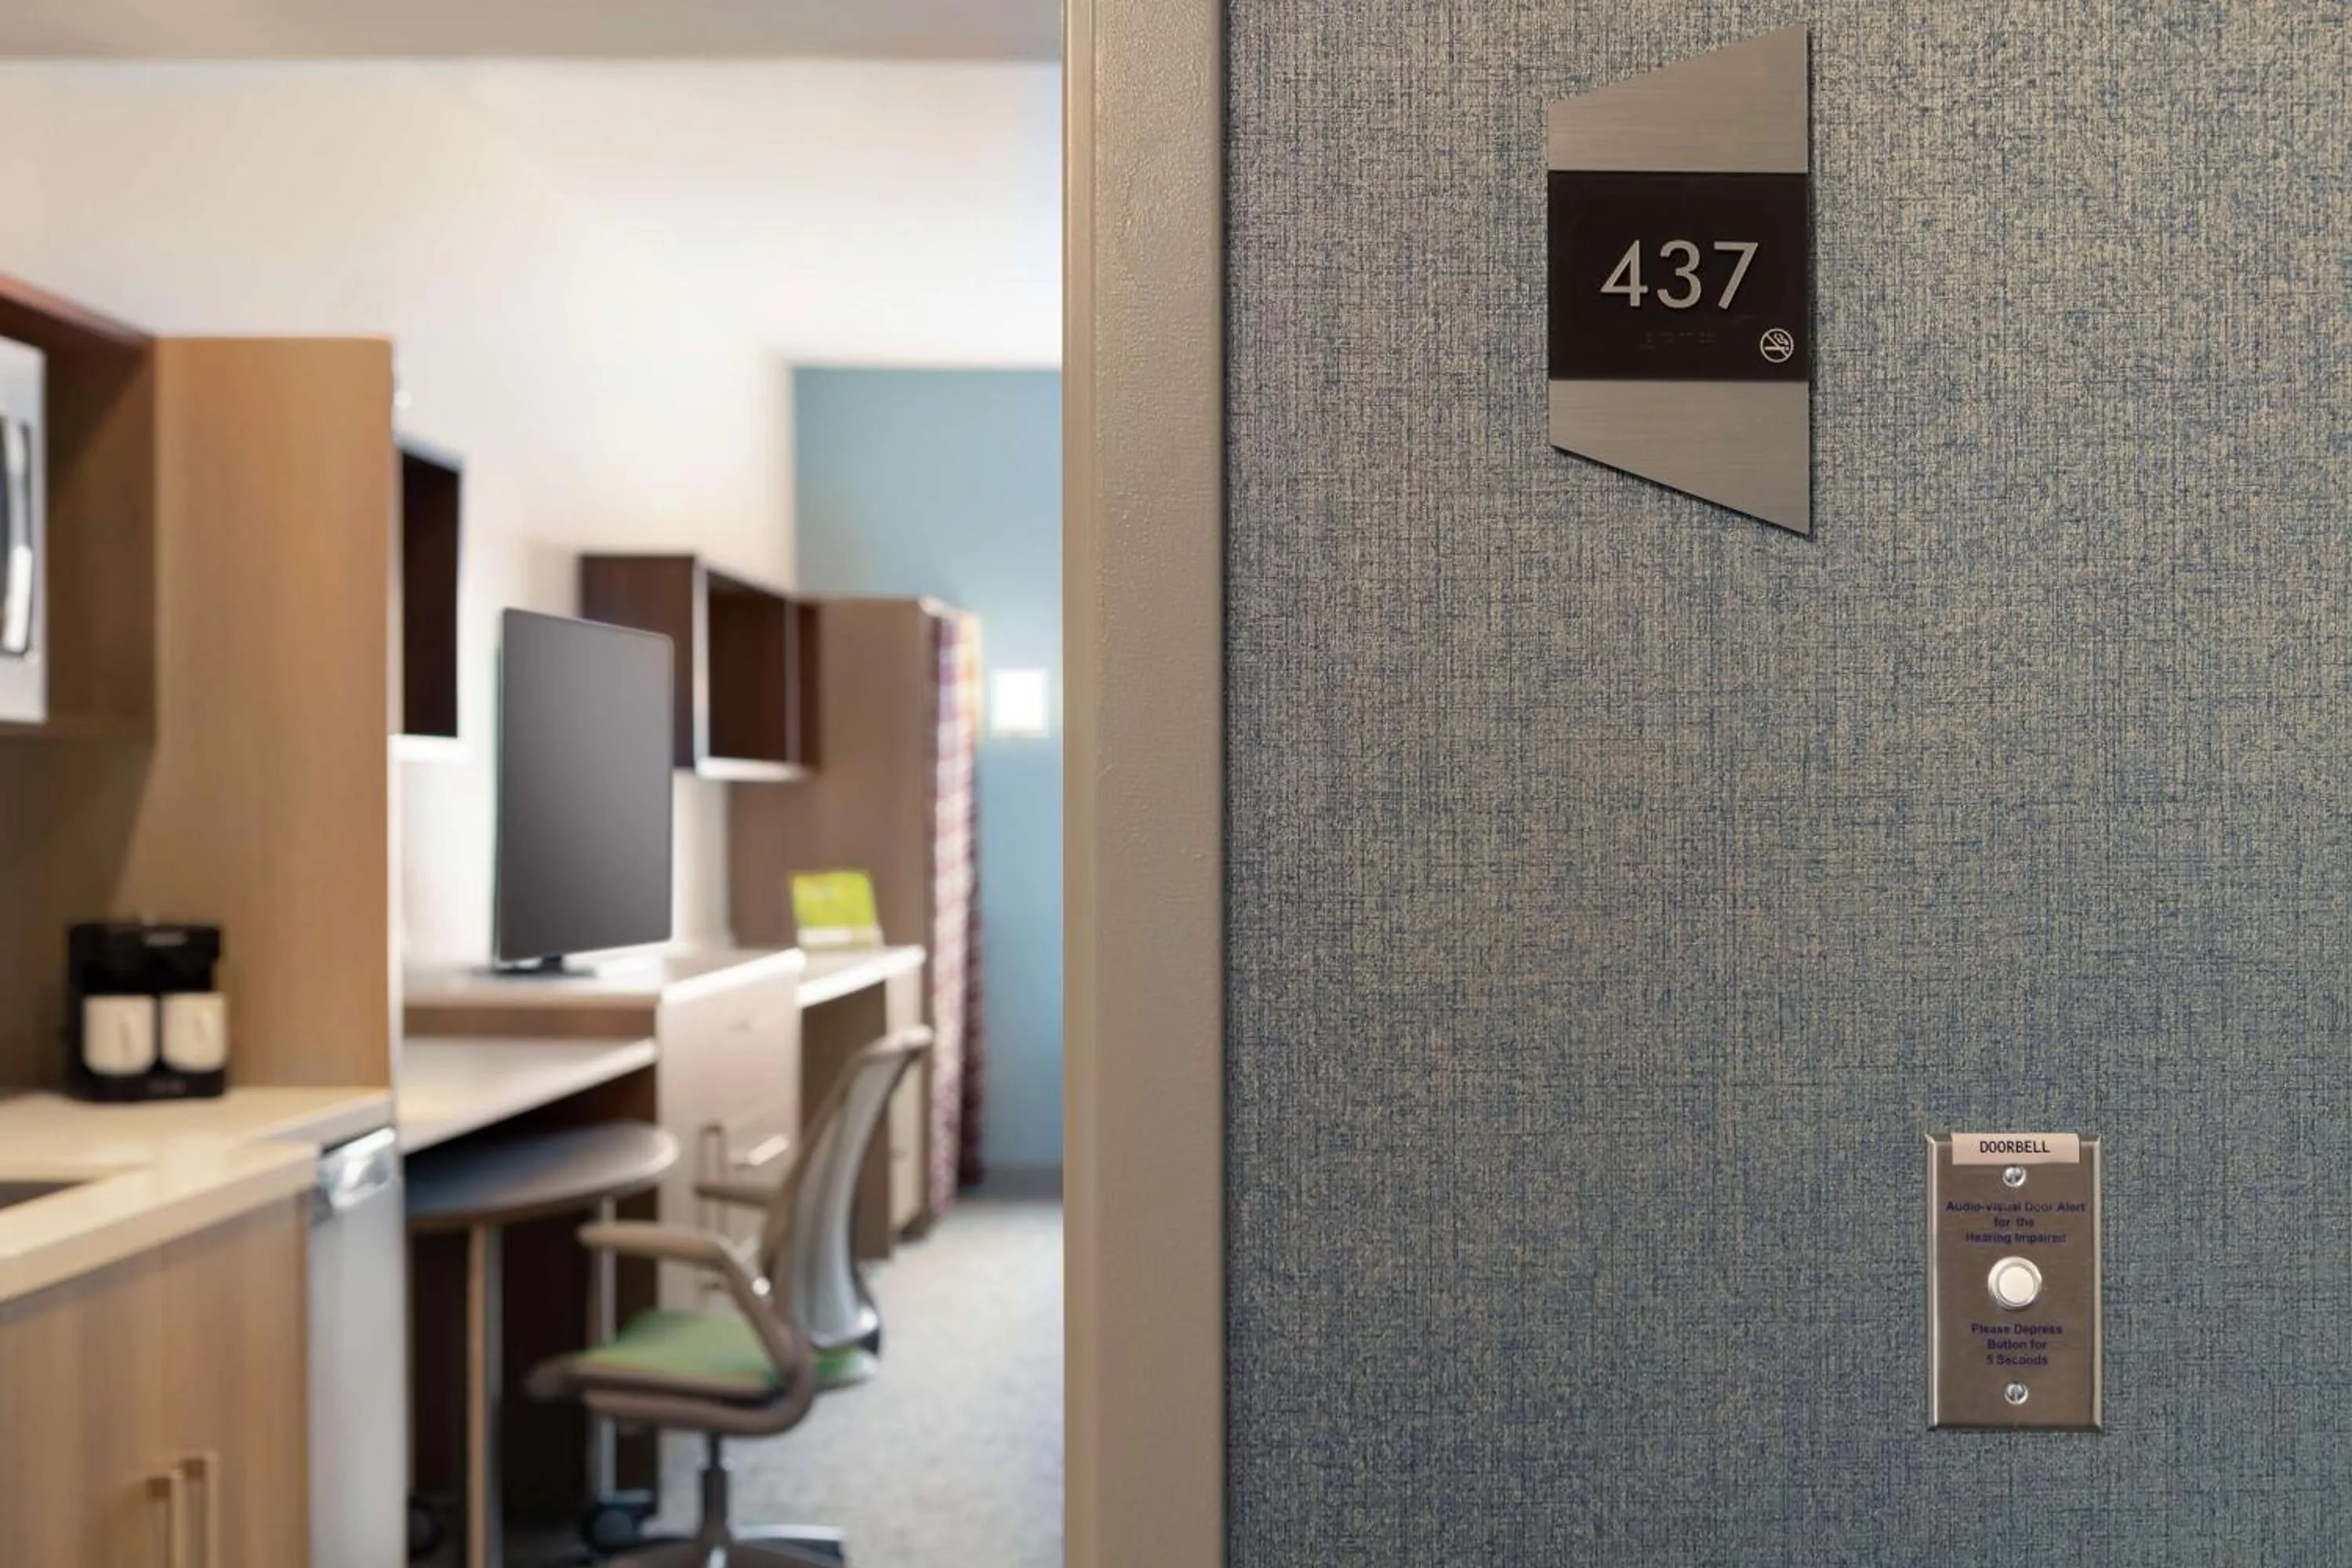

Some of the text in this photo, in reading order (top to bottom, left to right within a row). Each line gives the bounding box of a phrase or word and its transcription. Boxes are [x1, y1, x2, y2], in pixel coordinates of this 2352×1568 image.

[1600, 239, 1759, 310] 437
[1980, 1140, 2051, 1153] DOORBELL
[1946, 1200, 2085, 1212] Audio-visual Door Alert
[1994, 1217, 2034, 1227] for the
[1965, 1232, 2067, 1244] Hearing Impaired
[1971, 1323, 2063, 1335] Please Depress
[1987, 1338, 2047, 1349] Button for
[1986, 1354, 2048, 1365] 5 Seconds
